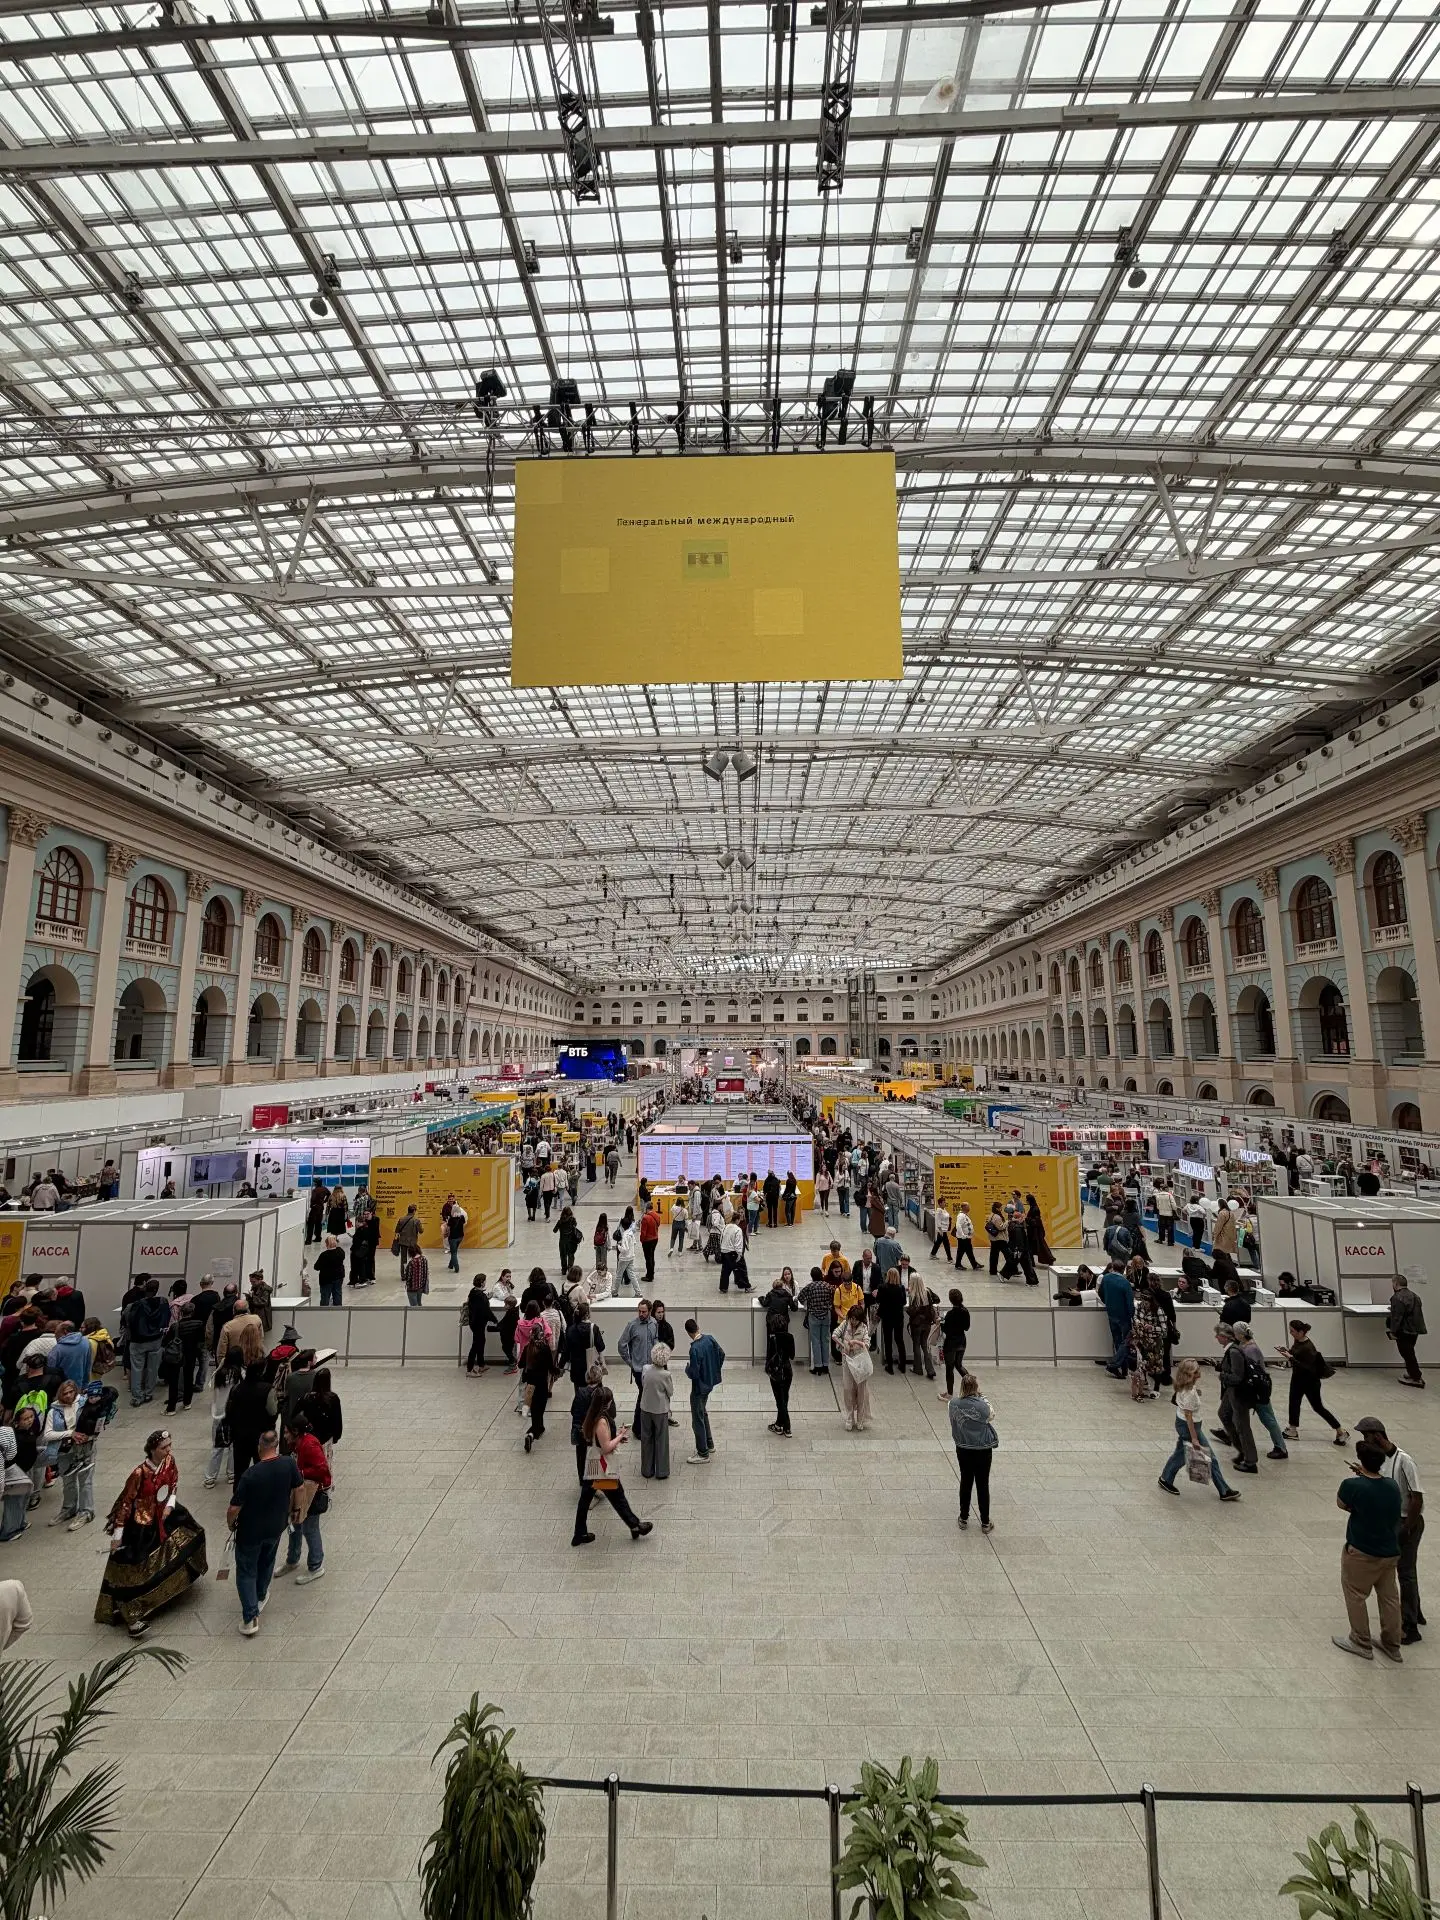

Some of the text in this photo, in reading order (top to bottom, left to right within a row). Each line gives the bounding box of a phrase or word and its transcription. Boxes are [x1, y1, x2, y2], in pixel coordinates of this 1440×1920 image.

[616, 514, 796, 527] Генеральный международный
[567, 1047, 589, 1057] ВТБ
[1178, 1158, 1214, 1180] КНИЖНАЯ
[32, 1246, 70, 1257] КАССА
[140, 1246, 179, 1256] КАССА
[1344, 1245, 1386, 1257] КАССА
